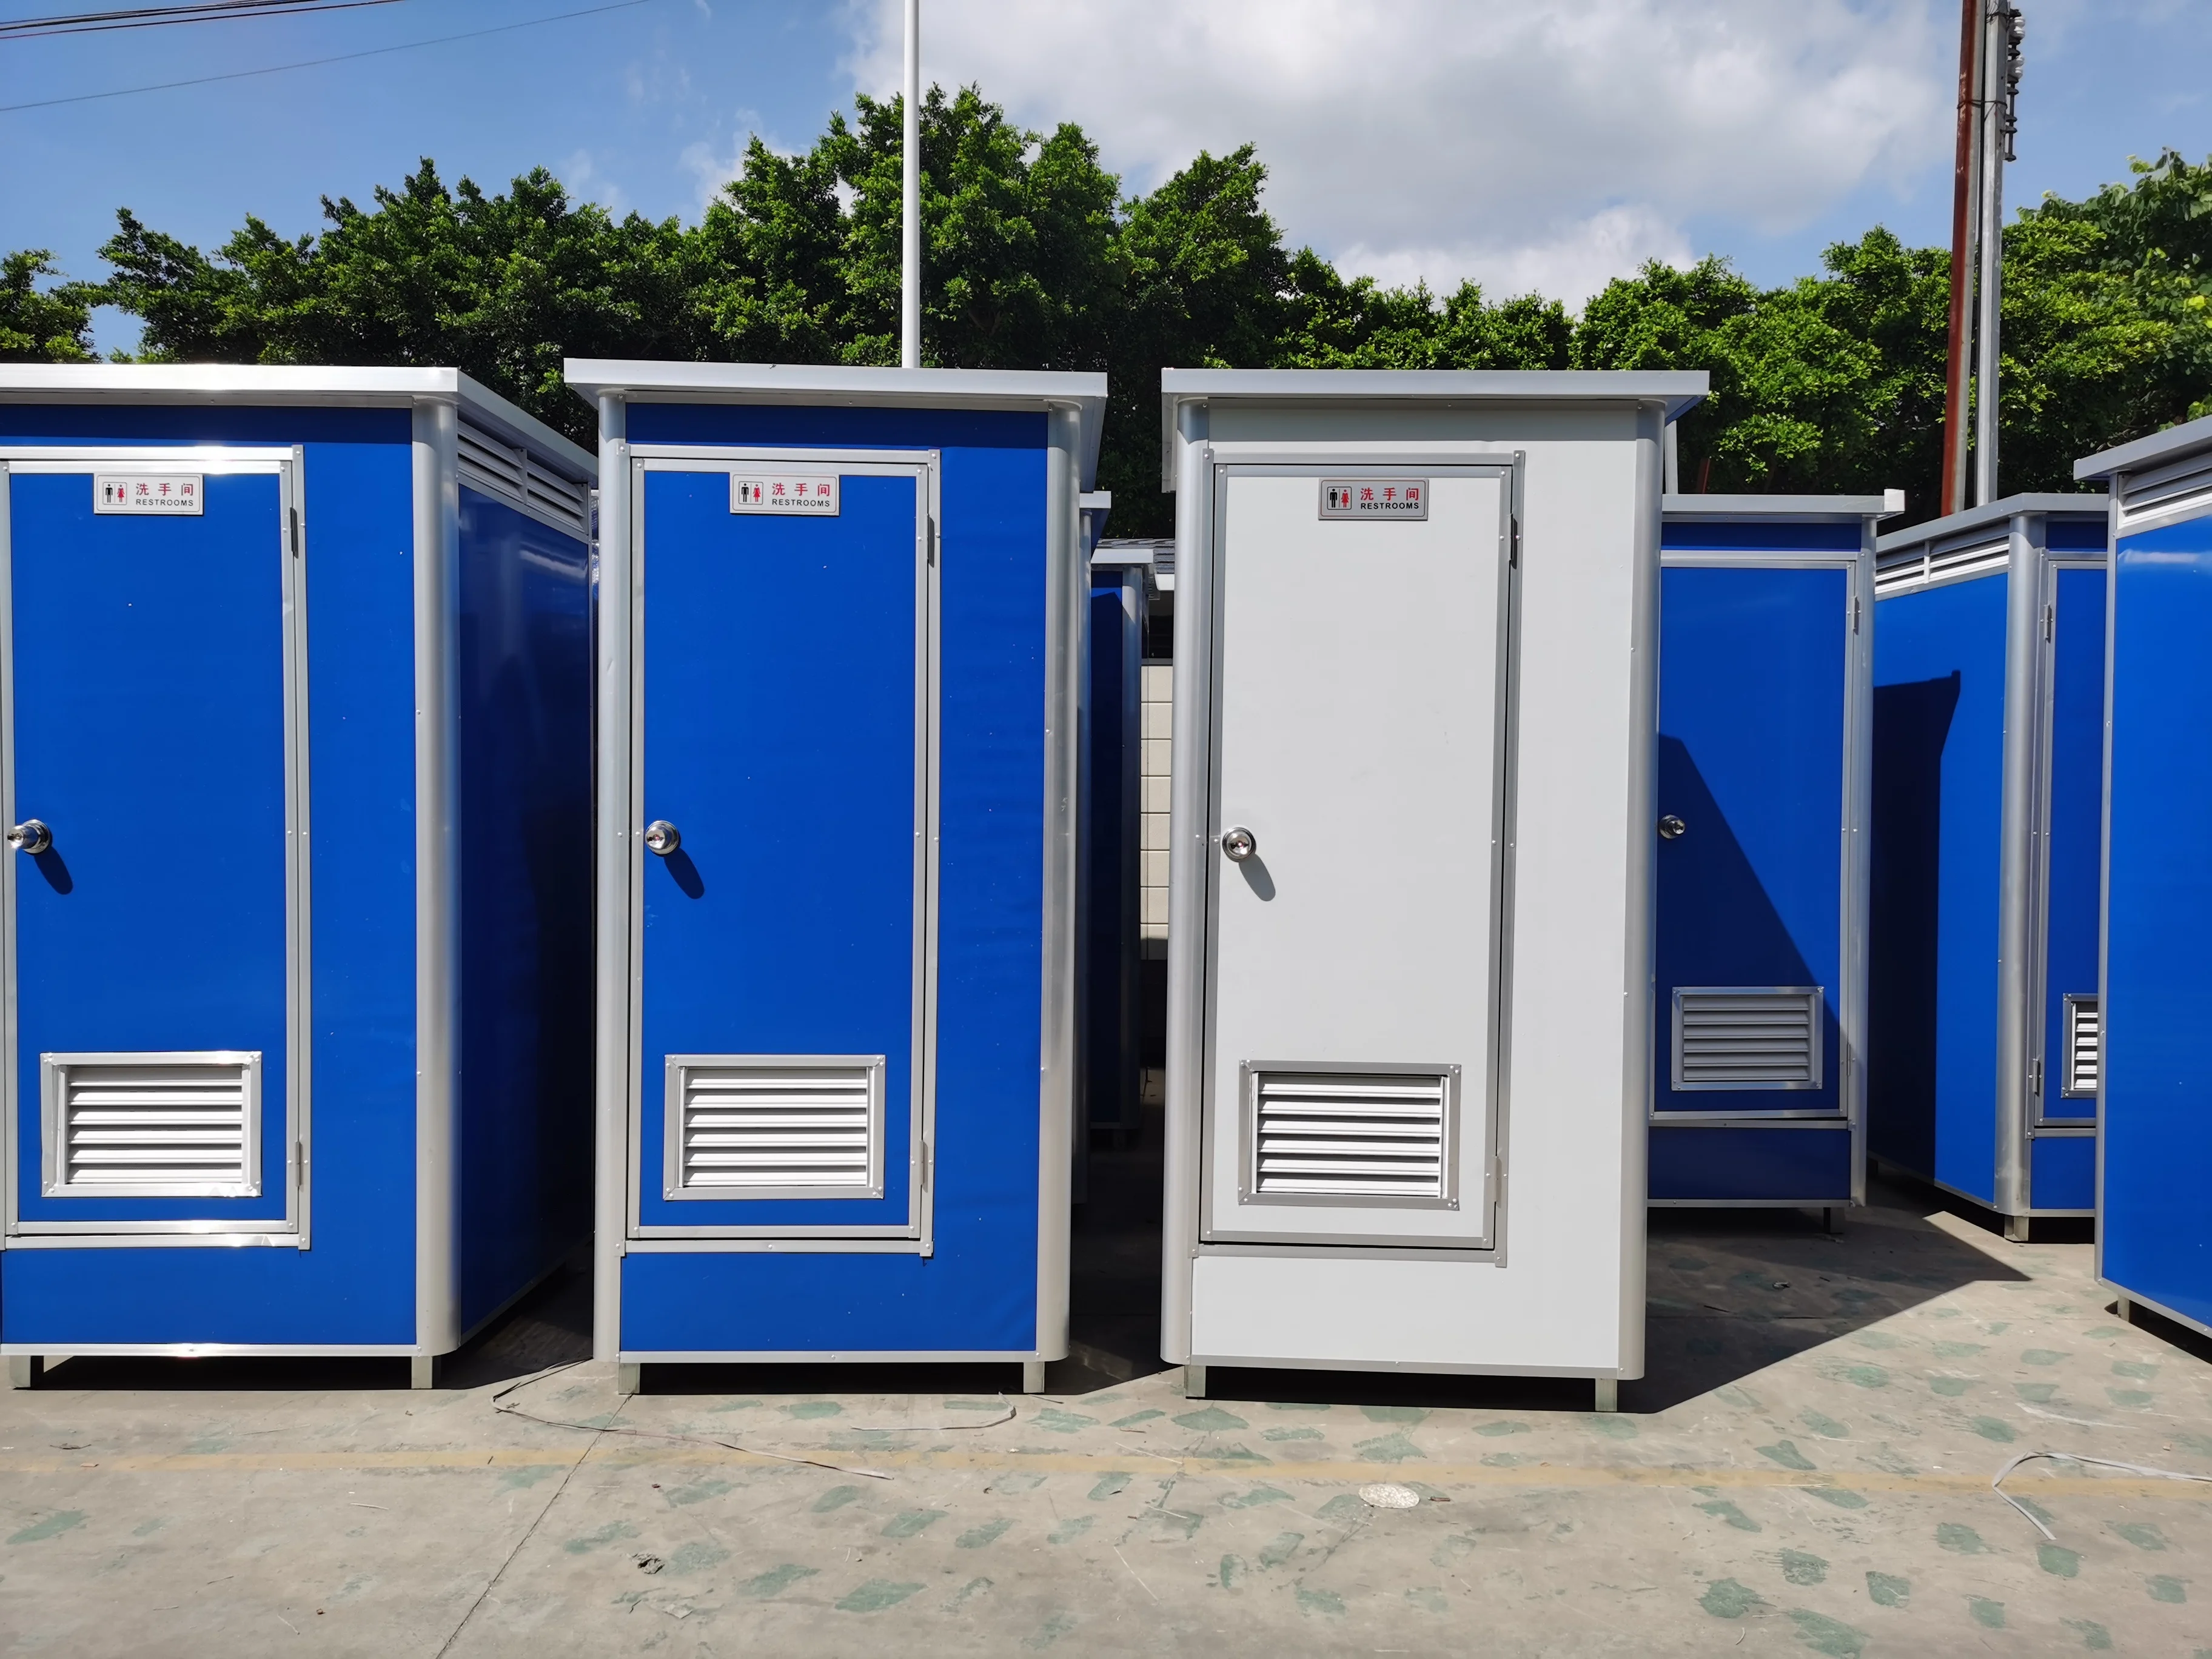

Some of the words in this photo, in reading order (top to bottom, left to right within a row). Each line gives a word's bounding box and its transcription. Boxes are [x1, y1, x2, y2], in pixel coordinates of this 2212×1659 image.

[135, 483, 193, 497] 洗手间
[772, 482, 830, 497] 洗手间
[1360, 487, 1419, 501] 洗手间
[772, 498, 830, 507] RESTROOMS
